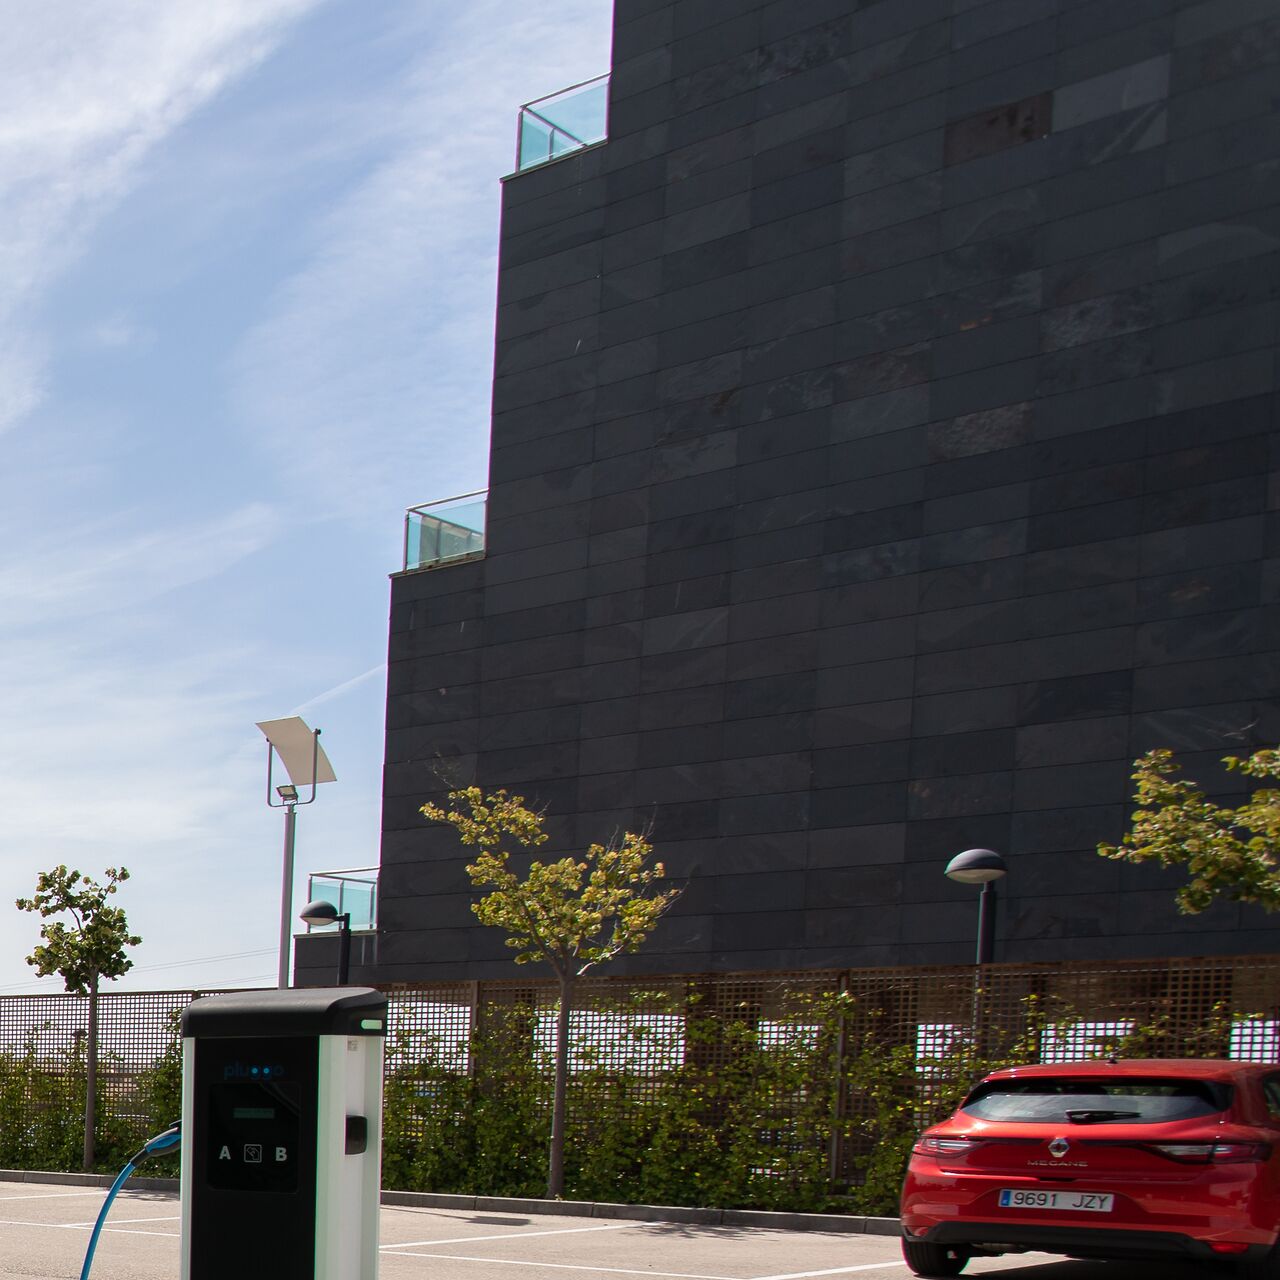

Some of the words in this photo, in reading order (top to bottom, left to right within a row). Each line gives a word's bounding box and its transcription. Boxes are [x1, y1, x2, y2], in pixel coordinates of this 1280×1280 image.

[224, 1061, 285, 1080] pluggo
[219, 1145, 231, 1160] A
[275, 1147, 288, 1161] B
[1014, 1192, 1058, 1207] 9691
[1072, 1195, 1110, 1209] JZY
